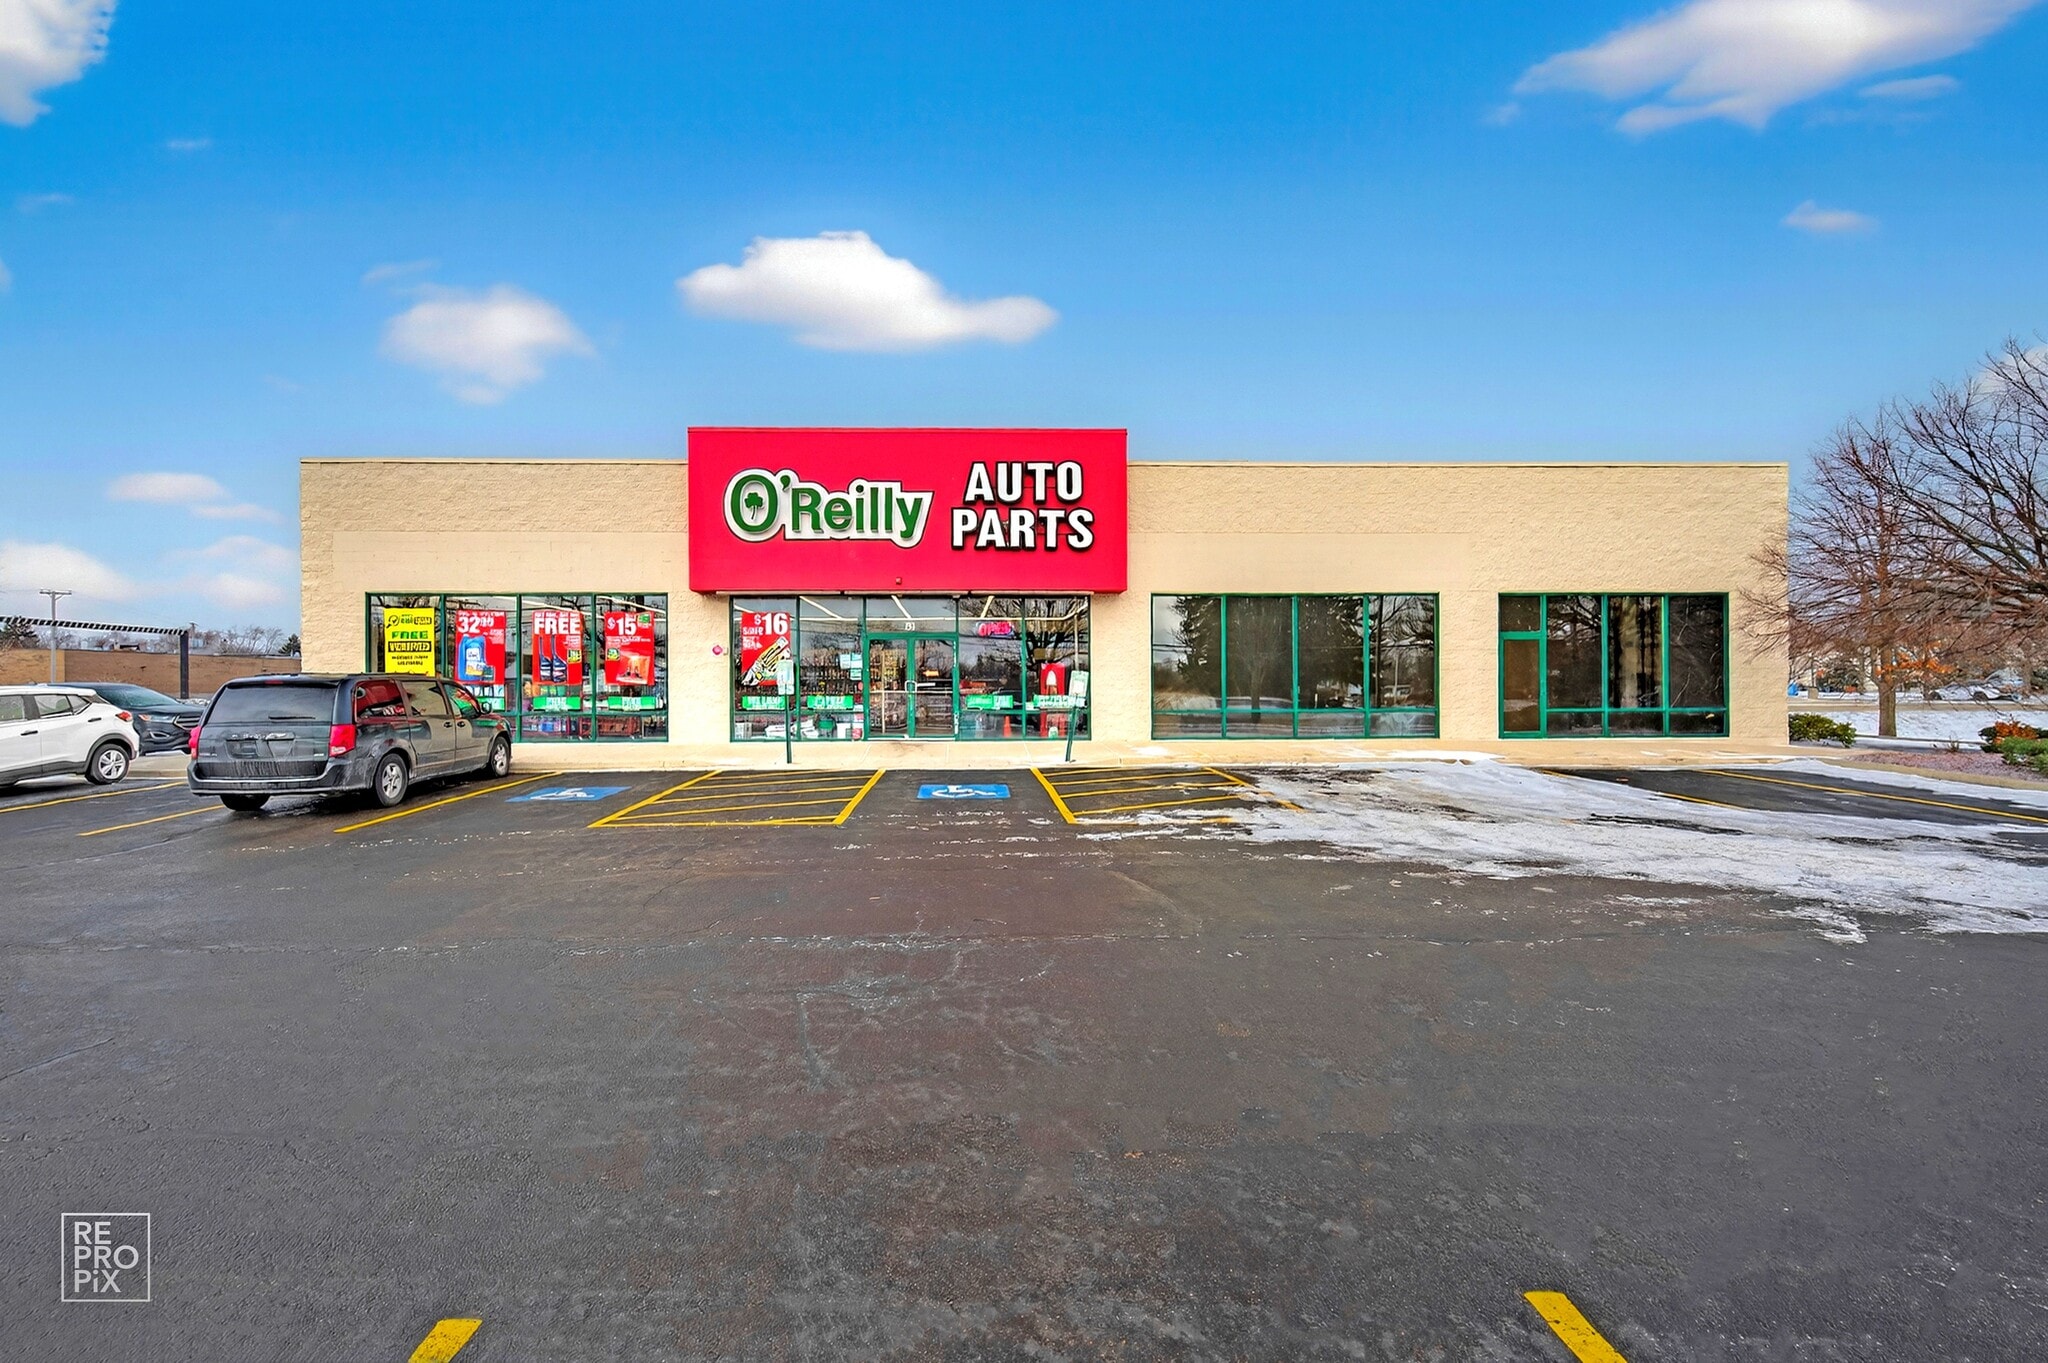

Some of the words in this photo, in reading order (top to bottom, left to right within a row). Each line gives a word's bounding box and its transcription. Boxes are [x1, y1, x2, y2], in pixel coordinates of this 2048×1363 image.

[964, 460, 1083, 503] AUTO
[730, 473, 923, 540] O'Reilly
[952, 508, 1094, 550] PARTS
[534, 617, 581, 635] FREE
[754, 612, 788, 636] $16
